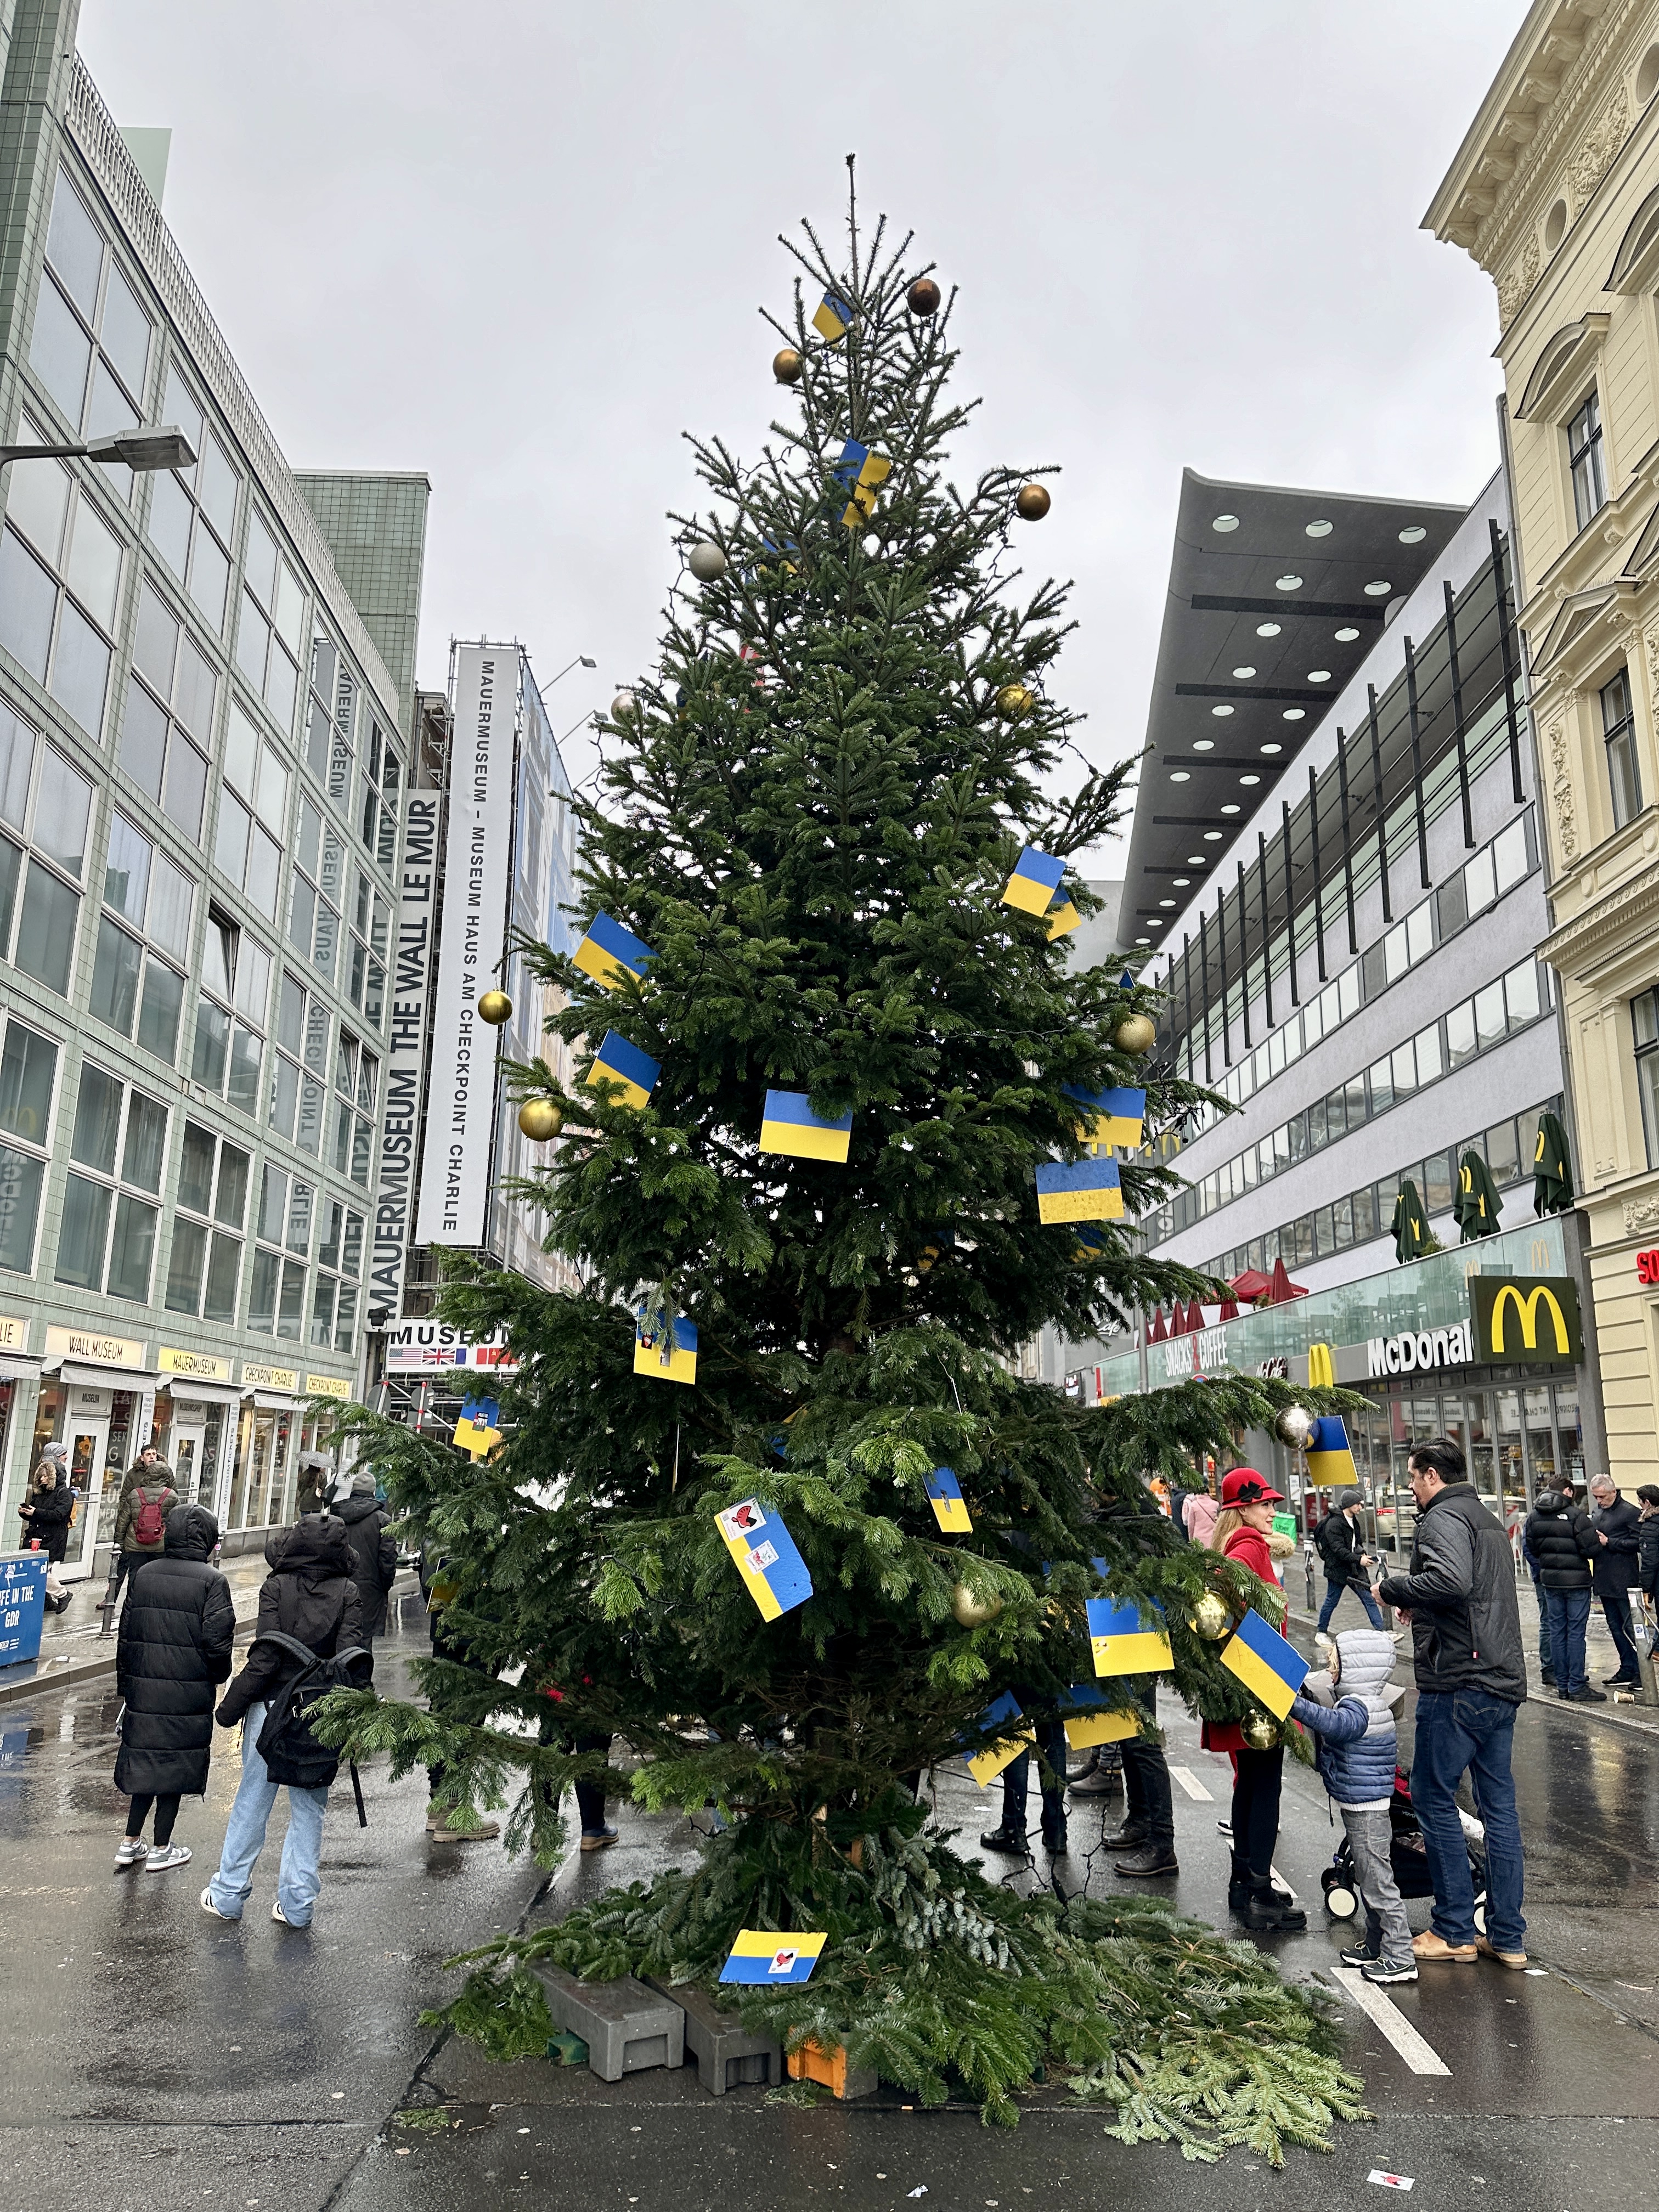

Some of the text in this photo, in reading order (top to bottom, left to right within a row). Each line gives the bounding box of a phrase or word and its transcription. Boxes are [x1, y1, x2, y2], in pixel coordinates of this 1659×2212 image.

[473, 661, 494, 803] MAUERMUSEUM
[468, 827, 485, 906] MUSEUM
[464, 916, 479, 965] HAUS
[461, 973, 476, 1001] AM
[369, 799, 436, 1319] MAUERMUSEUM THE WALL LE MUR
[450, 1009, 472, 1136] CHECKPOINT
[443, 1144, 464, 1231] CHARLIE
[1637, 1250, 1659, 1284] SO
[69, 1335, 123, 1361] WALL MUSEUM
[173, 1353, 216, 1376] MAUERMUSEUM
[1165, 1325, 1228, 1377] SNACKS & COFFEE
[246, 1367, 292, 1387] CHECKPOINT CHARLIE
[309, 1378, 347, 1395] CHECKPOINT CHARLIE
[12, 1587, 20, 1604] IN
[21, 1585, 35, 1602] THE
[5, 1610, 20, 1628] GDR
